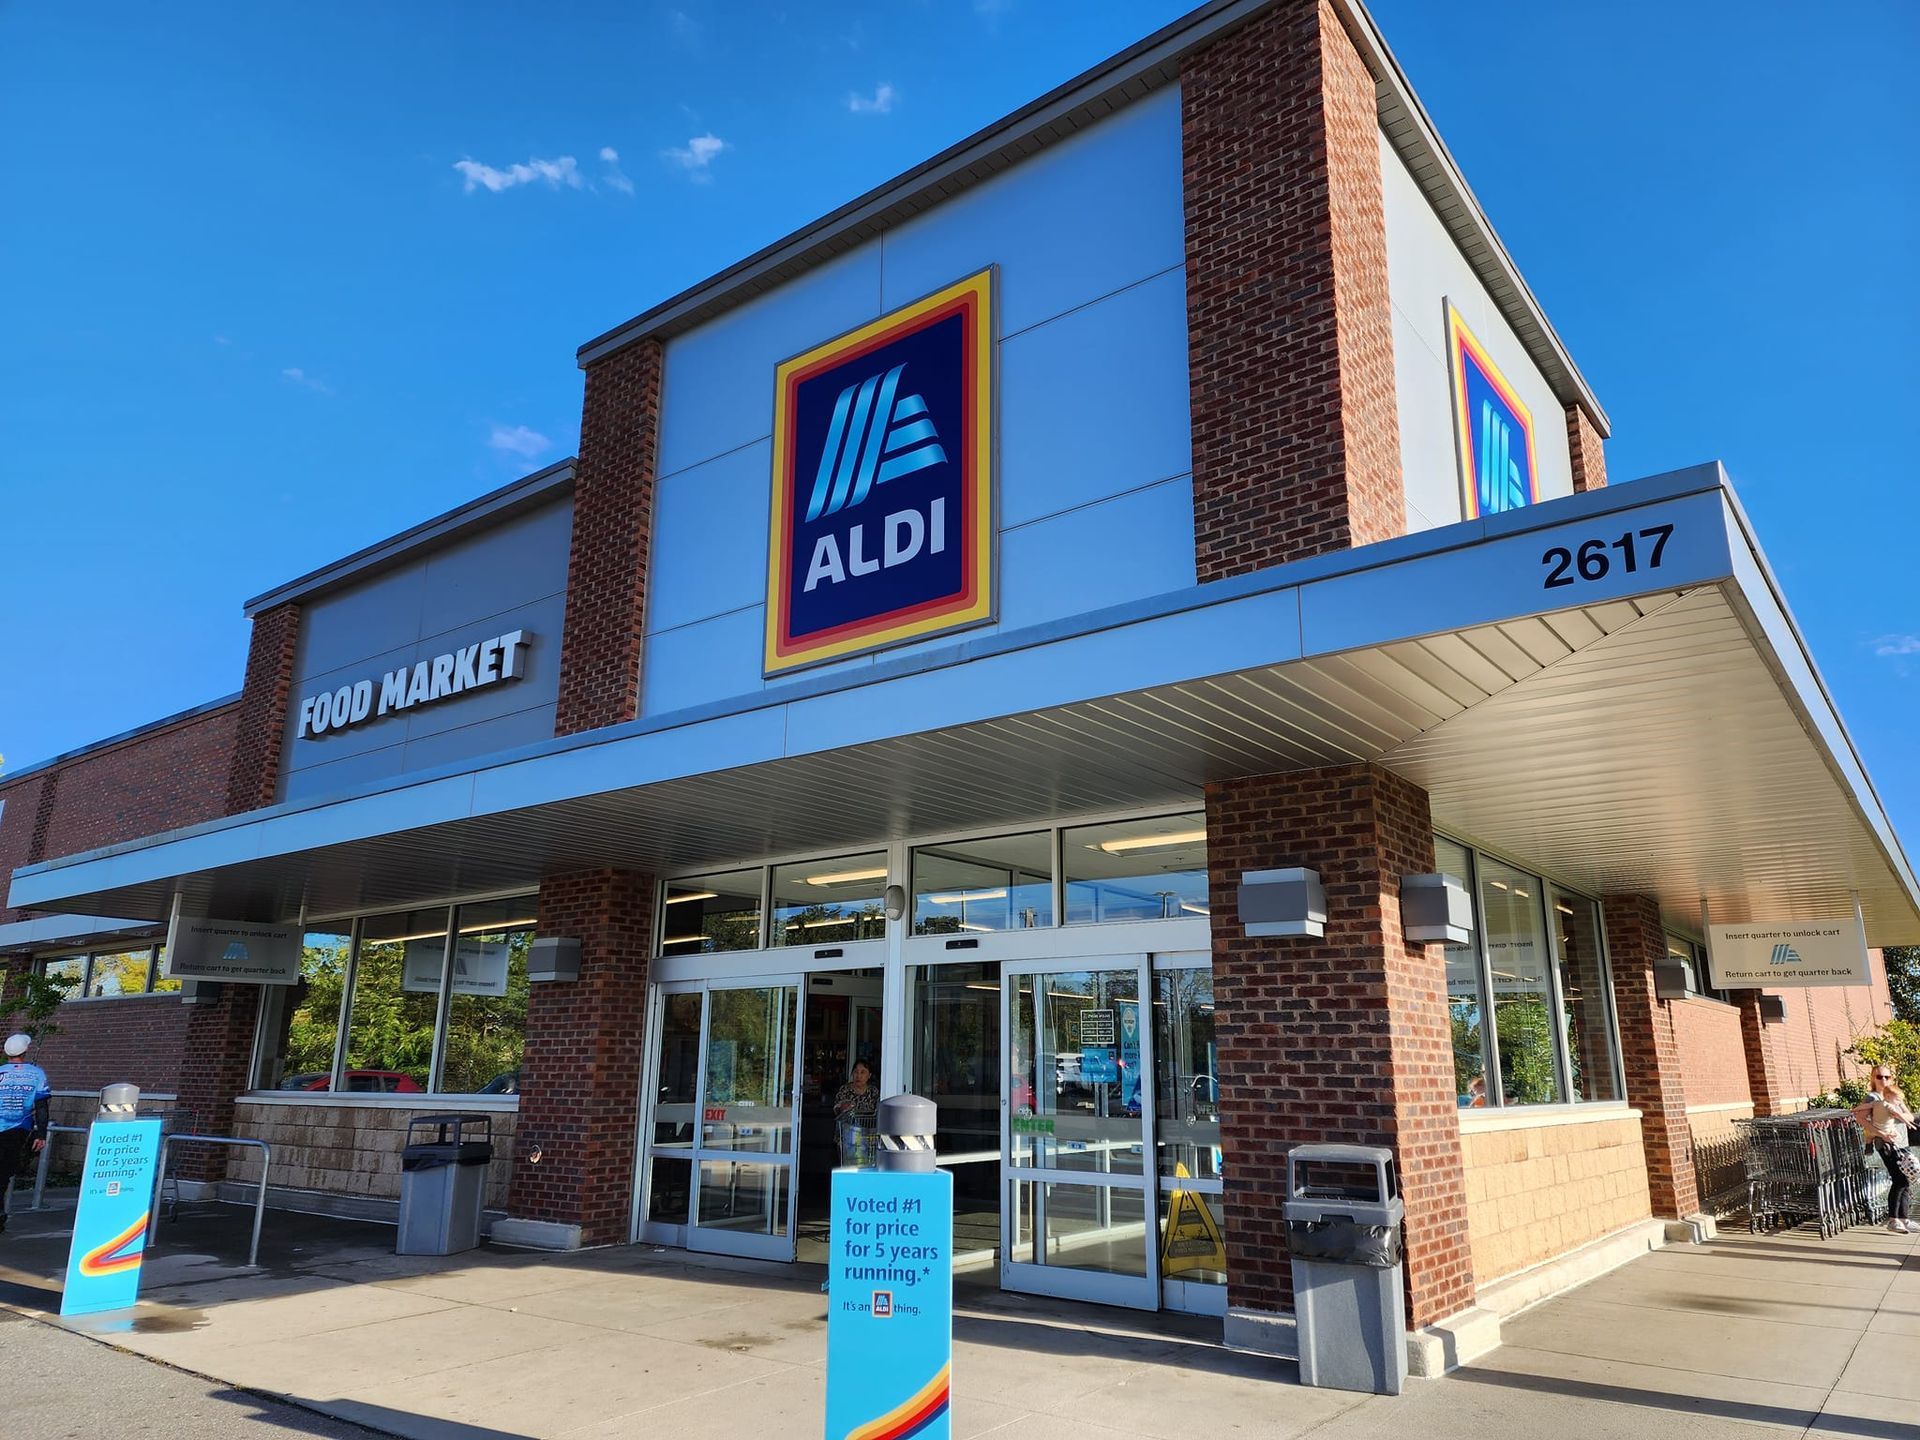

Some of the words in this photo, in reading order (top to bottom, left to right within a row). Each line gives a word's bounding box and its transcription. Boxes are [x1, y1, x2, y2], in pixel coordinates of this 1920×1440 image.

[804, 497, 945, 592] ALDI
[1542, 524, 1674, 589] 2617
[297, 679, 373, 739] FOOD
[377, 629, 523, 716] MARKET
[191, 926, 213, 934] Insert
[214, 928, 240, 936] quarter
[1725, 932, 1750, 940] Insert
[1750, 931, 1781, 940] quarter
[1793, 929, 1821, 937] unlock
[180, 962, 205, 971] Return
[1725, 970, 1754, 978] Return
[1773, 969, 1781, 977] to
[1783, 969, 1797, 978] get
[1798, 968, 1829, 977] quarter
[1831, 967, 1852, 976] back
[705, 1109, 726, 1120] EXIT
[1012, 1118, 1055, 1133] ENTER
[99, 1134, 129, 1144] Voted
[131, 1133, 143, 1142] #1
[97, 1146, 113, 1155] for
[113, 1145, 140, 1156] price
[95, 1158, 111, 1167] for
[112, 1157, 119, 1166] 5
[120, 1157, 149, 1167] years
[846, 1197, 897, 1214] Voted
[902, 1198, 922, 1214] #1
[845, 1218, 870, 1235] for
[876, 1219, 919, 1239] price
[844, 1240, 870, 1258] for
[875, 1242, 885, 1258] 5
[890, 1245, 938, 1263] years
[843, 1301, 856, 1311] It's
[858, 1303, 871, 1311] an
[893, 1303, 921, 1316] thing.
